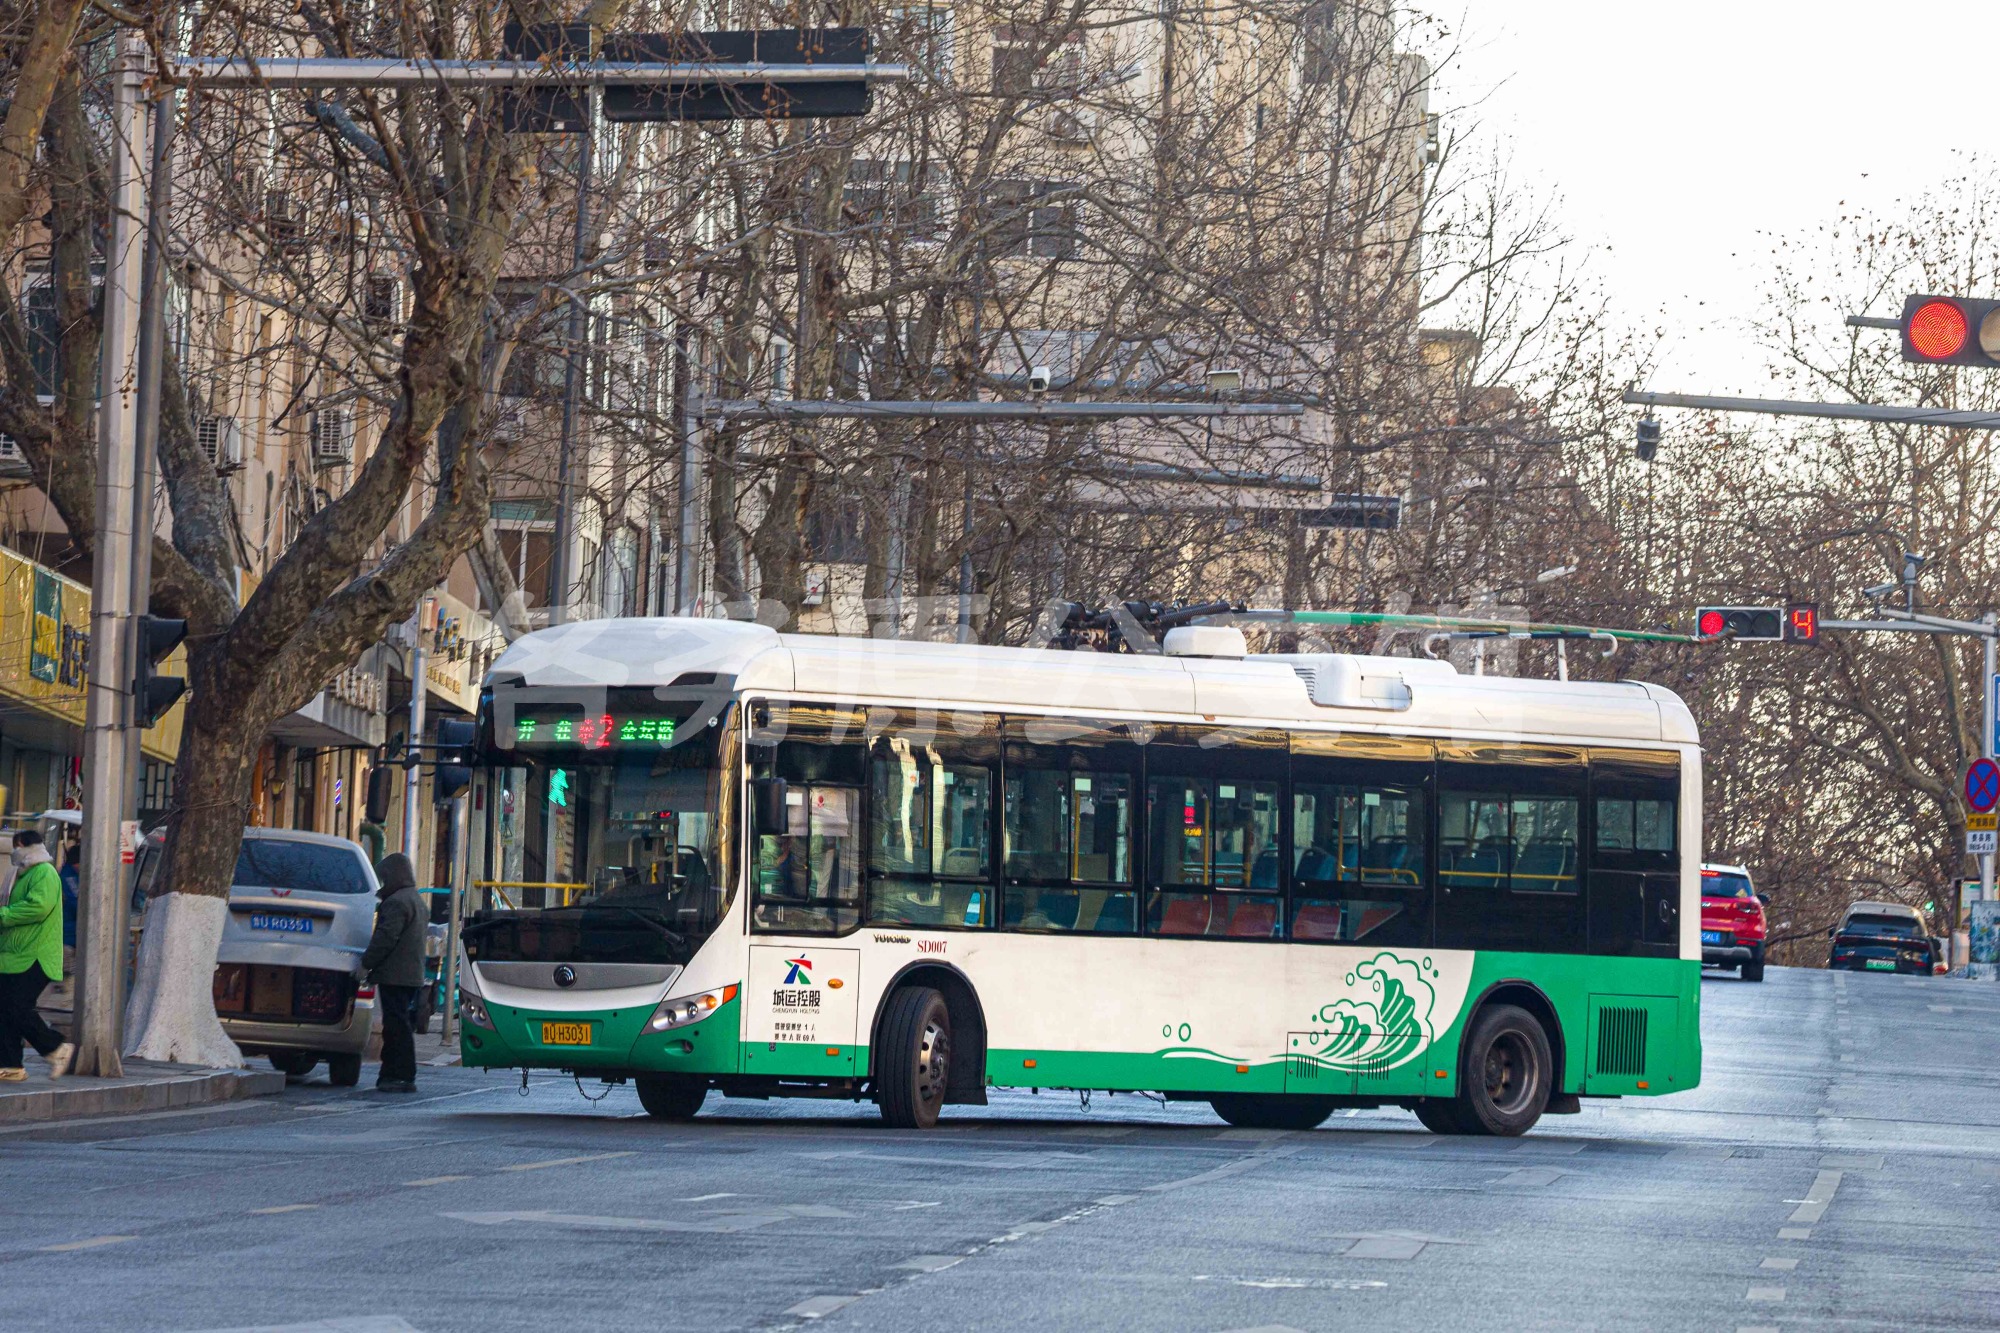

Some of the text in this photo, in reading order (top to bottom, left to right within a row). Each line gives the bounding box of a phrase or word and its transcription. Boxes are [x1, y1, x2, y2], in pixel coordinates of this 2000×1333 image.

[1792, 609, 1814, 639] 4
[917, 940, 948, 954] SD007
[773, 989, 821, 1007] 城运控股
